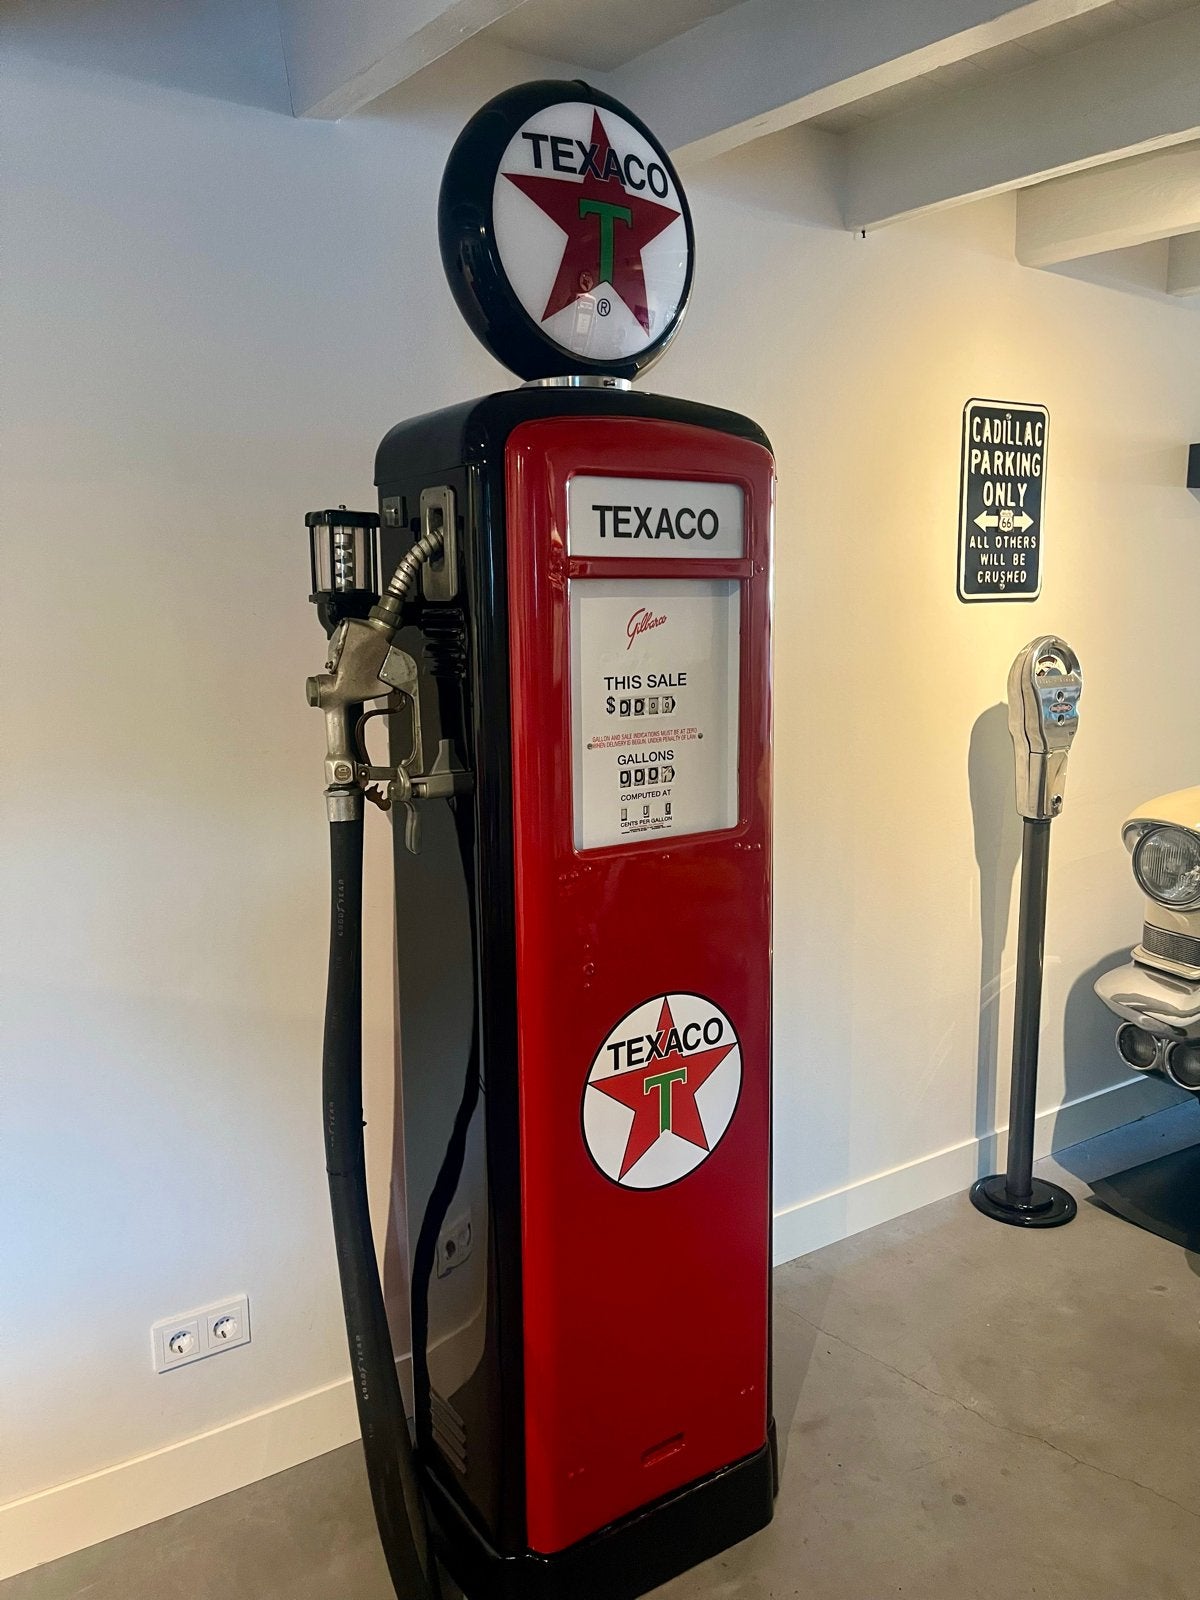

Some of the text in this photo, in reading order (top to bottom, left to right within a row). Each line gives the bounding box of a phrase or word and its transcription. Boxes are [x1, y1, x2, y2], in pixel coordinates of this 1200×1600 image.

[521, 132, 668, 198] TEXACO
[578, 198, 633, 286] T
[972, 415, 1043, 448] CADILLAC
[970, 448, 1041, 478] PARKING
[983, 481, 1028, 508] ONLY
[592, 504, 719, 540] TEXACO
[1001, 517, 1012, 529] 66
[969, 535, 1037, 549] ALL OTHERS
[980, 552, 1026, 566] WILL BE
[977, 569, 1027, 584] CRUSHED
[626, 607, 668, 651] Gilbarco
[603, 672, 687, 691] THIS SALE
[617, 749, 675, 766] GALLONS
[620, 788, 671, 802] COMPUTED AT
[620, 820, 638, 828] CENTS
[650, 815, 673, 824] GALLON
[606, 1017, 724, 1071] TEXACO
[644, 1066, 687, 1135] T
